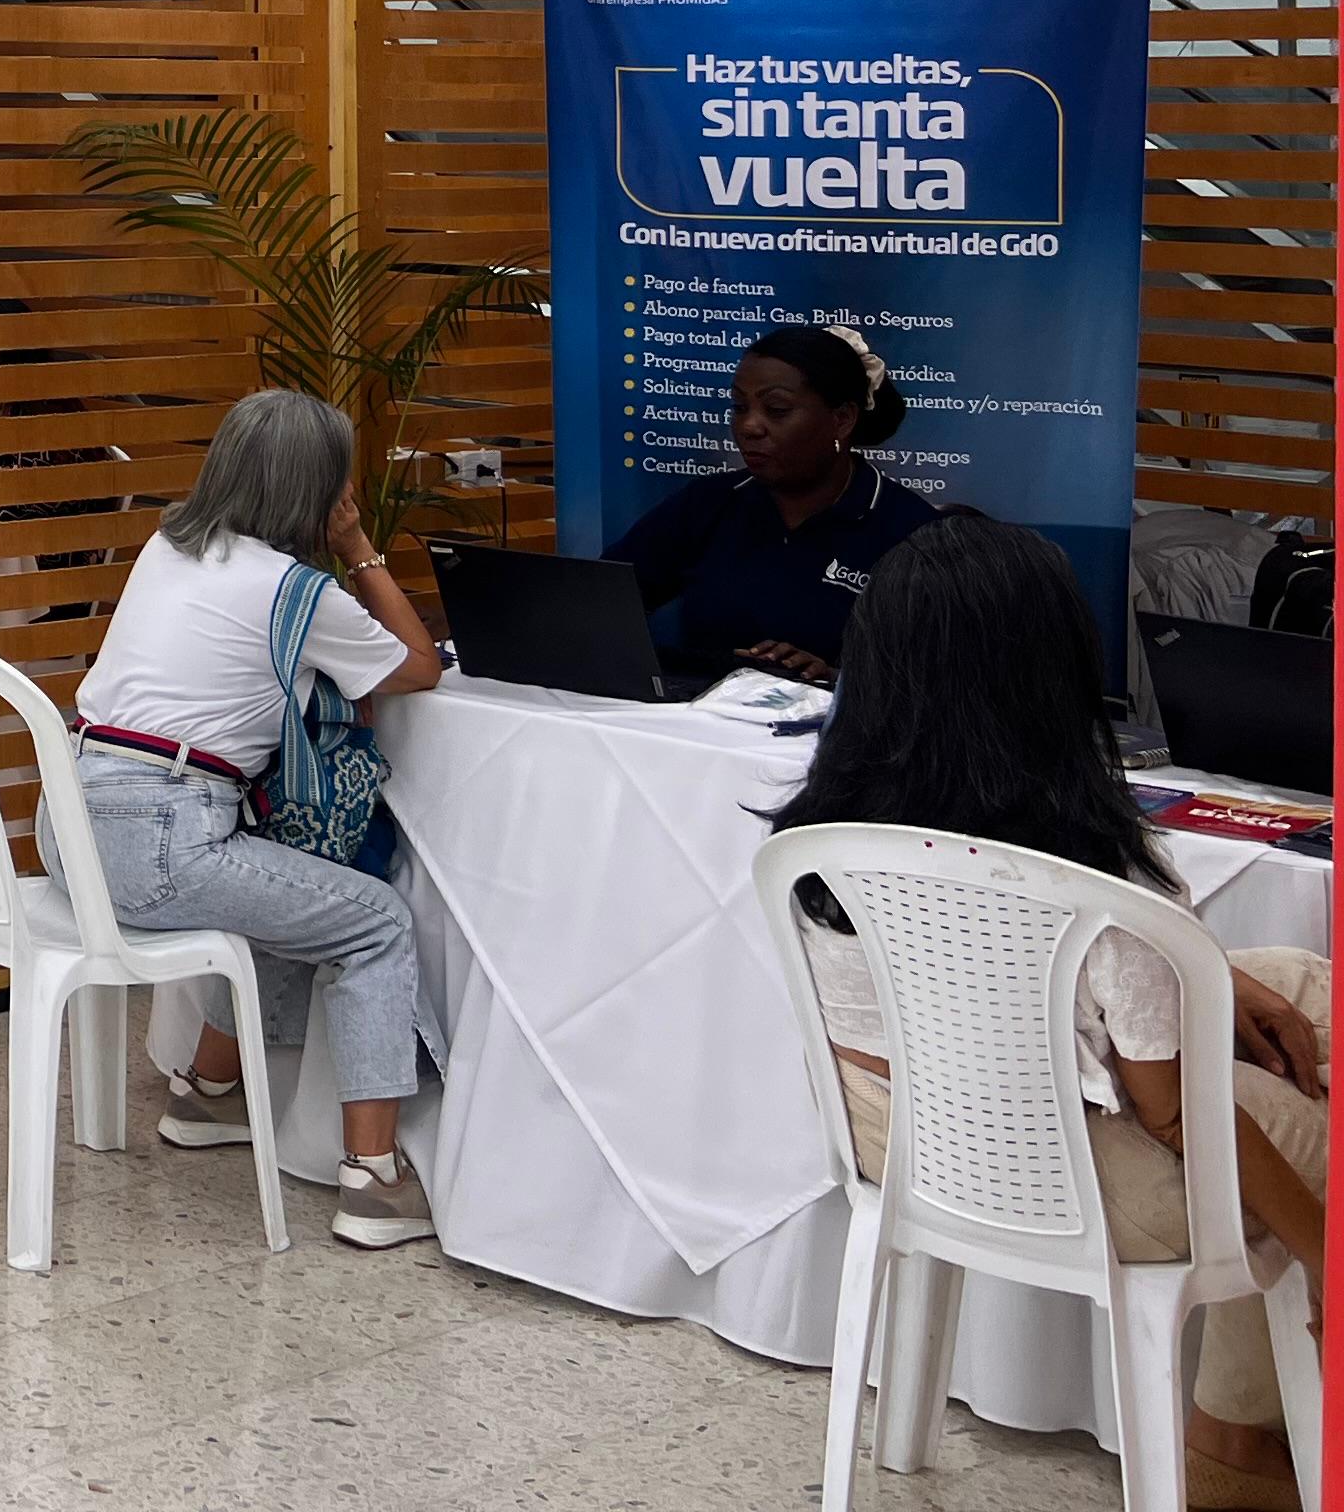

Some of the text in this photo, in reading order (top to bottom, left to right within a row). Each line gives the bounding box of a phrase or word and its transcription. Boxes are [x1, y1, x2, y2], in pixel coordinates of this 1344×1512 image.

[686, 53, 972, 88] Haz tus vueltas,
[701, 87, 966, 140] sin tanta
[699, 140, 966, 211] vuelta
[619, 221, 1060, 257] Con la nueva oficina virtual de GdO
[643, 274, 776, 296] Pago de factura
[642, 300, 954, 332] Abono parcial: Gas, Brilla o Seguros
[643, 326, 686, 347] Pago
[688, 330, 727, 347] total
[730, 332, 752, 348] de
[885, 365, 956, 382] riódica
[642, 405, 698, 423] Activa
[701, 410, 720, 425] tu
[643, 378, 714, 399] Solicitar
[902, 394, 965, 411] miento
[967, 393, 1000, 416] y/o
[1002, 397, 1104, 417] reparación
[642, 431, 971, 468] Consulta tu uras y pagos
[642, 457, 946, 494] Certificad pago
